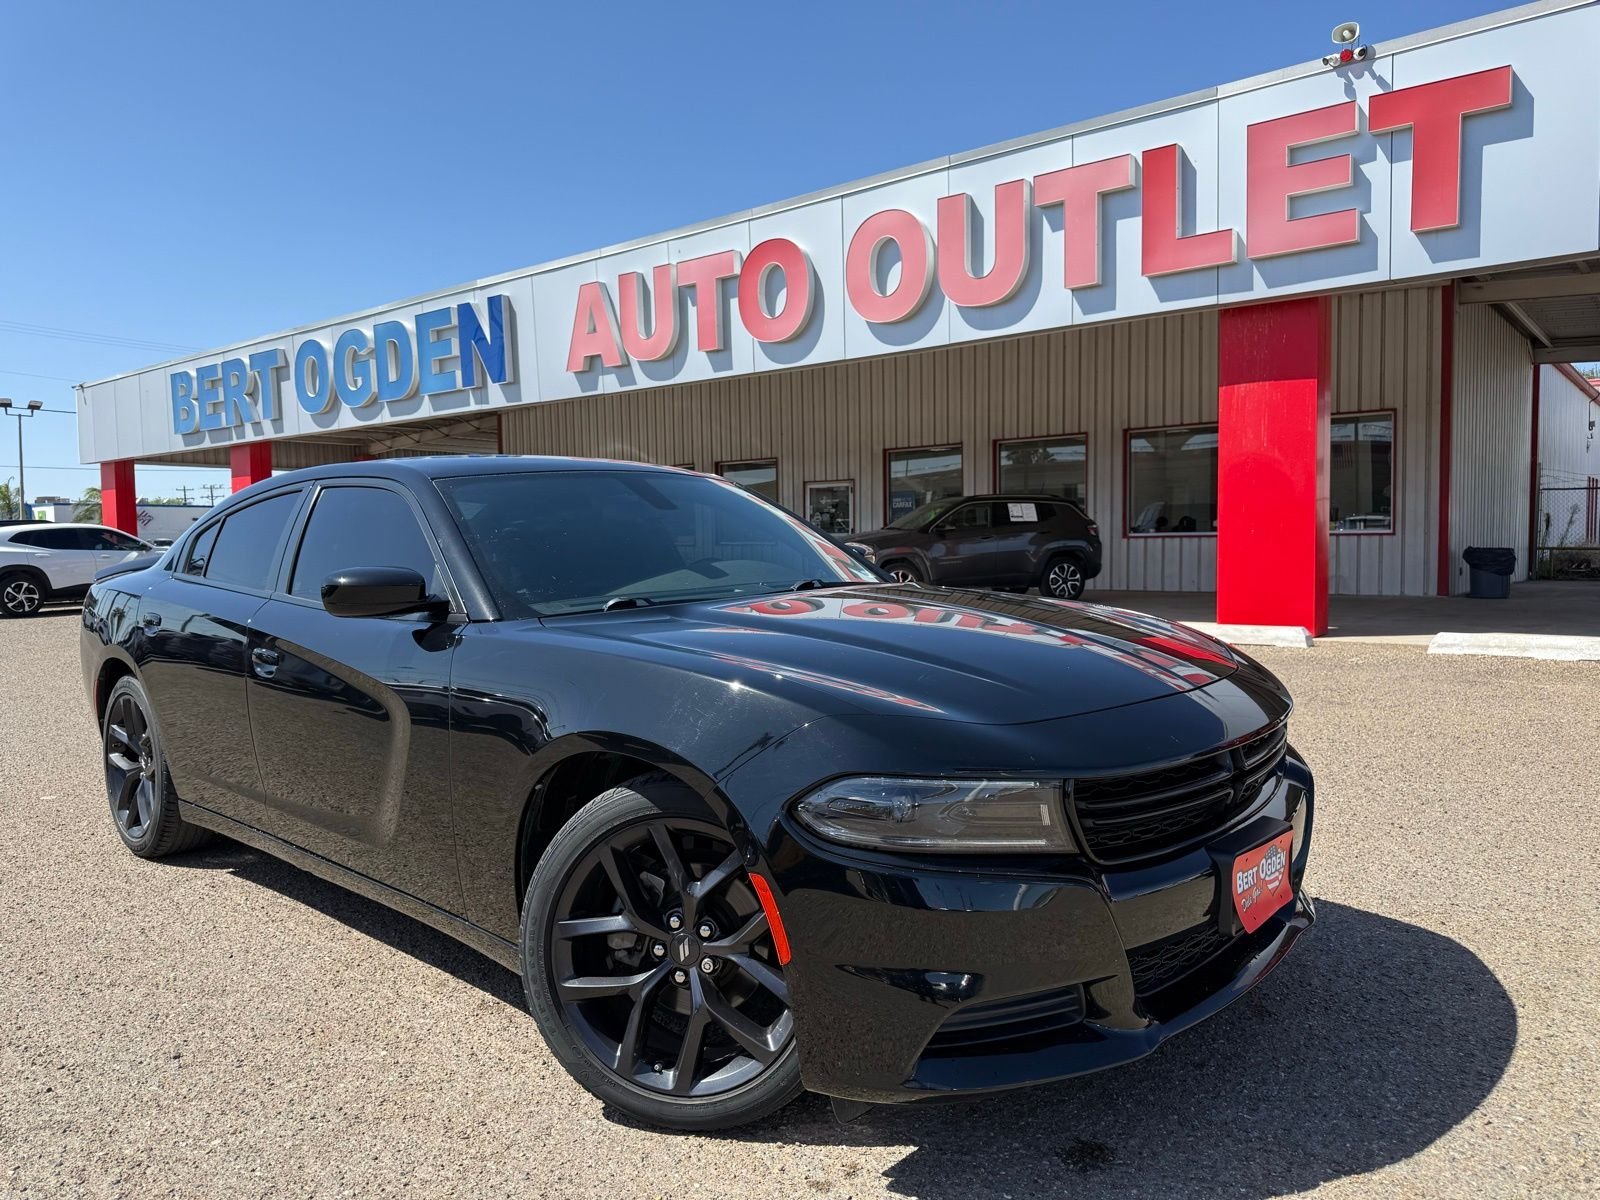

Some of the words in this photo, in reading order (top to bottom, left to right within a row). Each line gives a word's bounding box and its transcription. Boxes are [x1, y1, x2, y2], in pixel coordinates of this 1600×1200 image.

[170, 347, 287, 435] BERT
[294, 293, 513, 415] OGDEN
[566, 237, 815, 373] AUTO
[845, 65, 1514, 325] OUTLET
[1236, 866, 1258, 895] BERT
[1260, 850, 1286, 879] OGDEN
